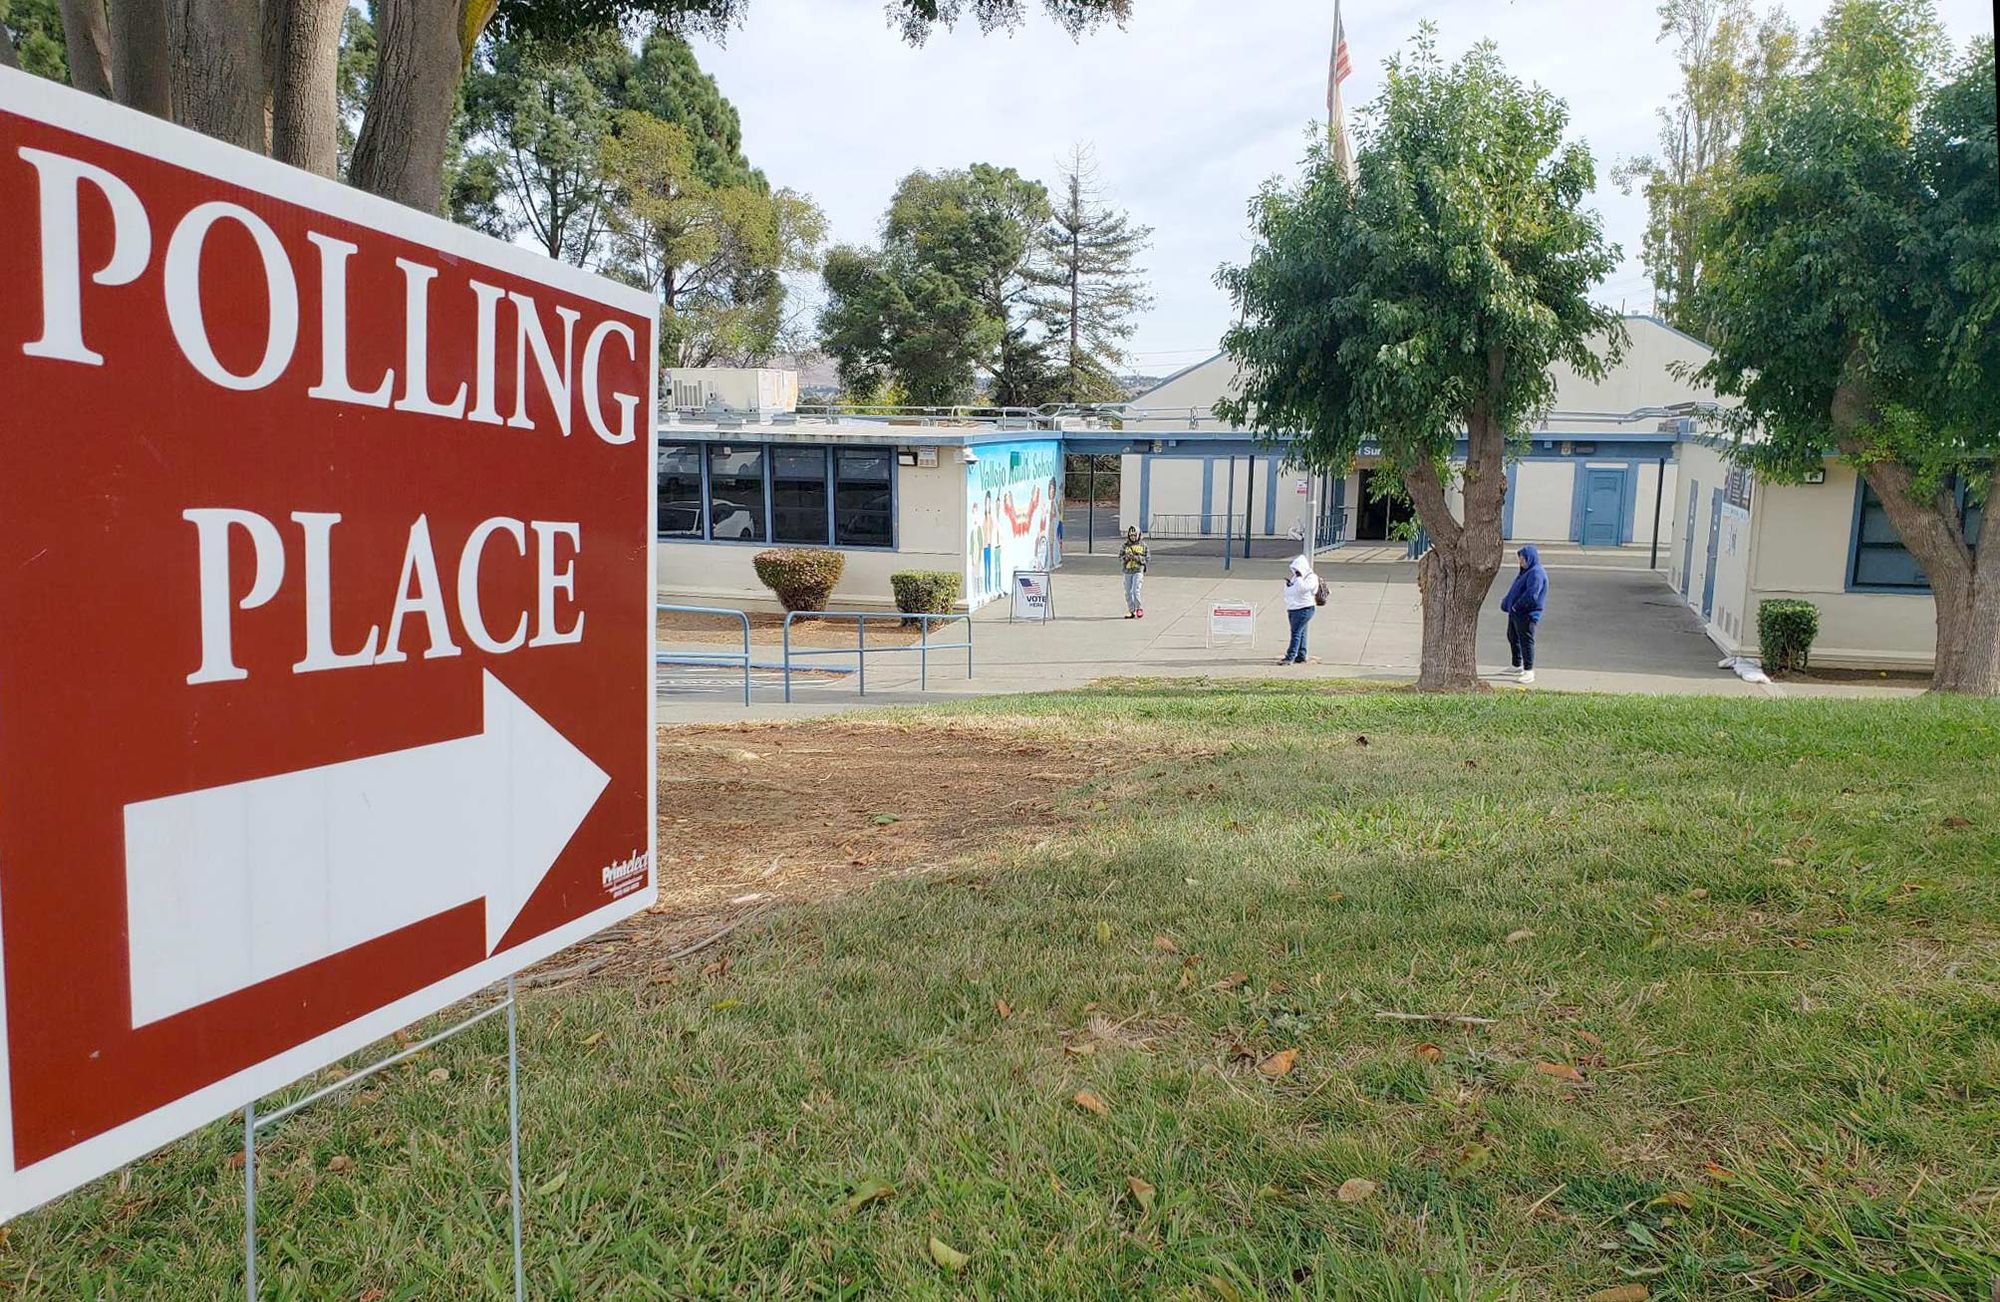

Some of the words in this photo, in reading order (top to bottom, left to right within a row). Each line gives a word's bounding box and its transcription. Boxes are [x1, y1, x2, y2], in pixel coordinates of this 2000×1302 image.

[18, 146, 640, 445] POLLING
[980, 460, 1006, 492] Vallejo
[1033, 450, 1056, 480] School
[182, 508, 585, 685] PLACE
[1026, 595, 1047, 603] VOTE
